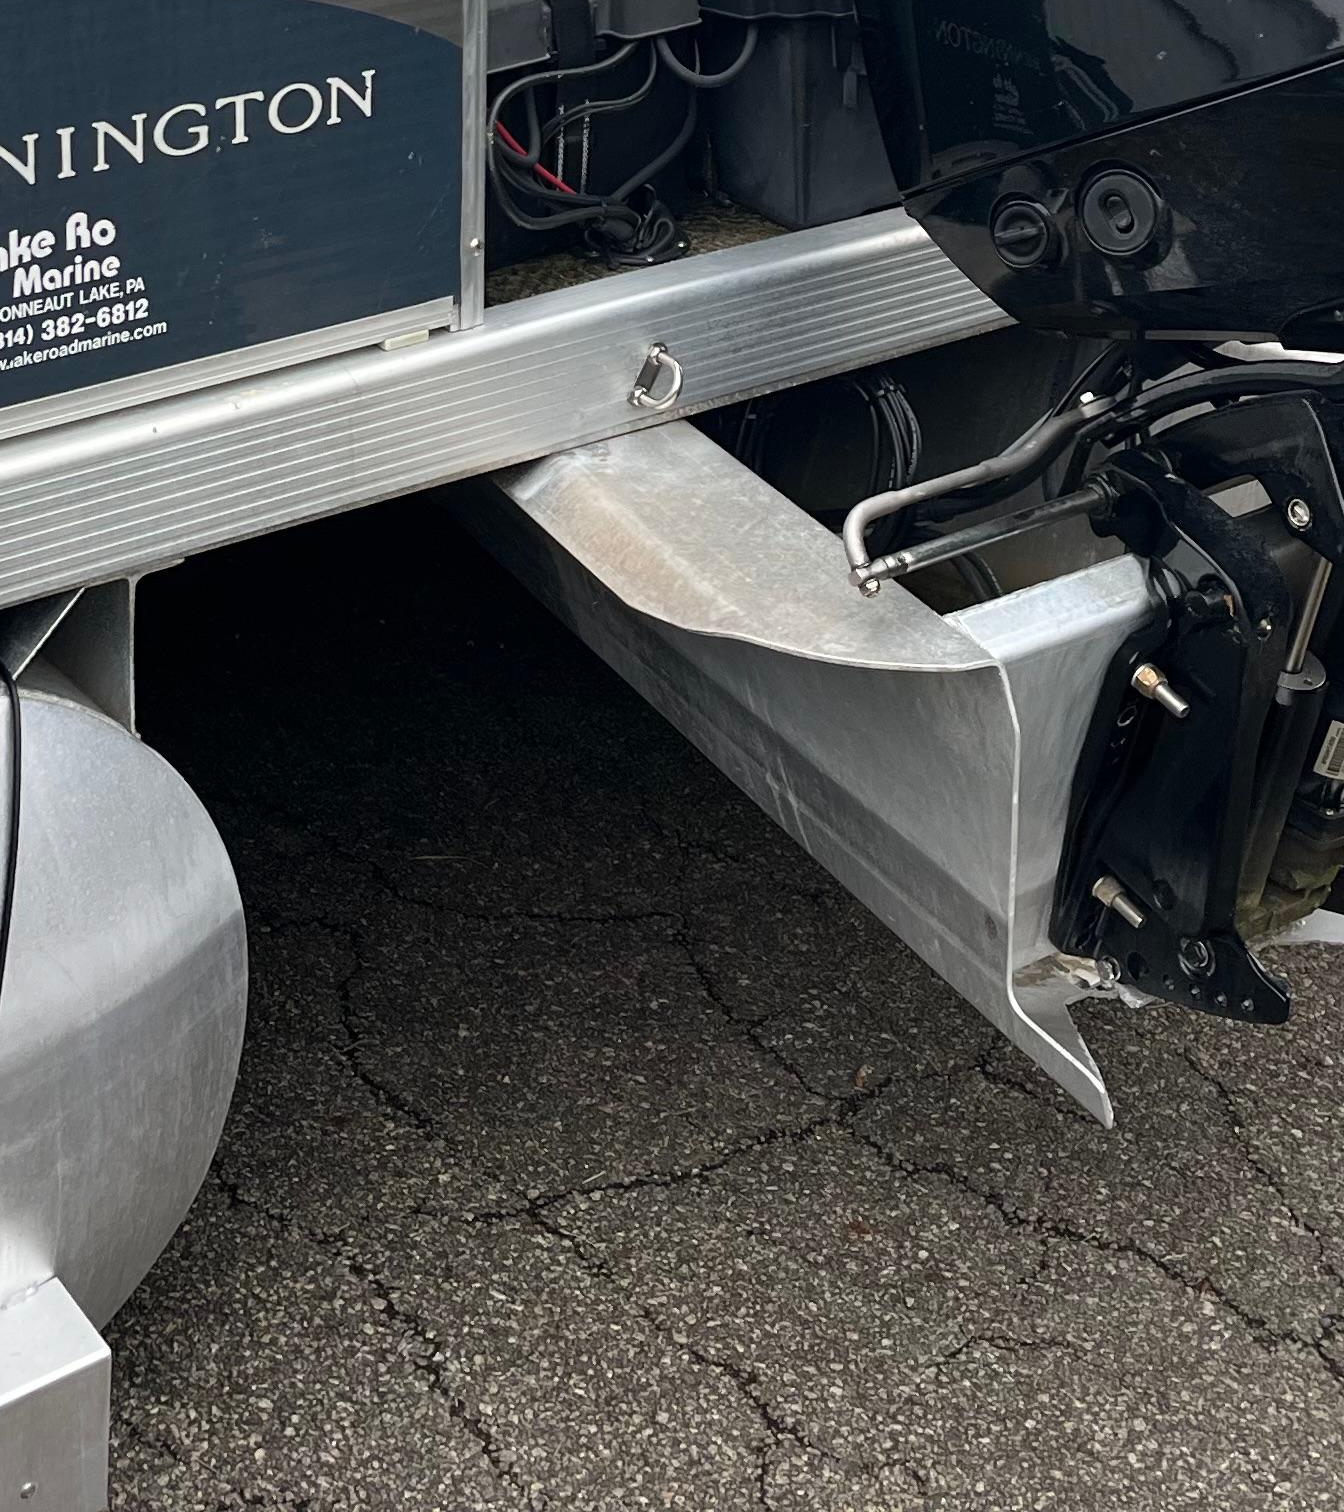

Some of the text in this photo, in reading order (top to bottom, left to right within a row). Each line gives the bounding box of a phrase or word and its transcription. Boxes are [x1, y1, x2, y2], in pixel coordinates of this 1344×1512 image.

[13, 255, 121, 298] Marine
[79, 282, 124, 304] LAKE,
[126, 277, 146, 295] PA
[41, 298, 149, 341] 382-6812
